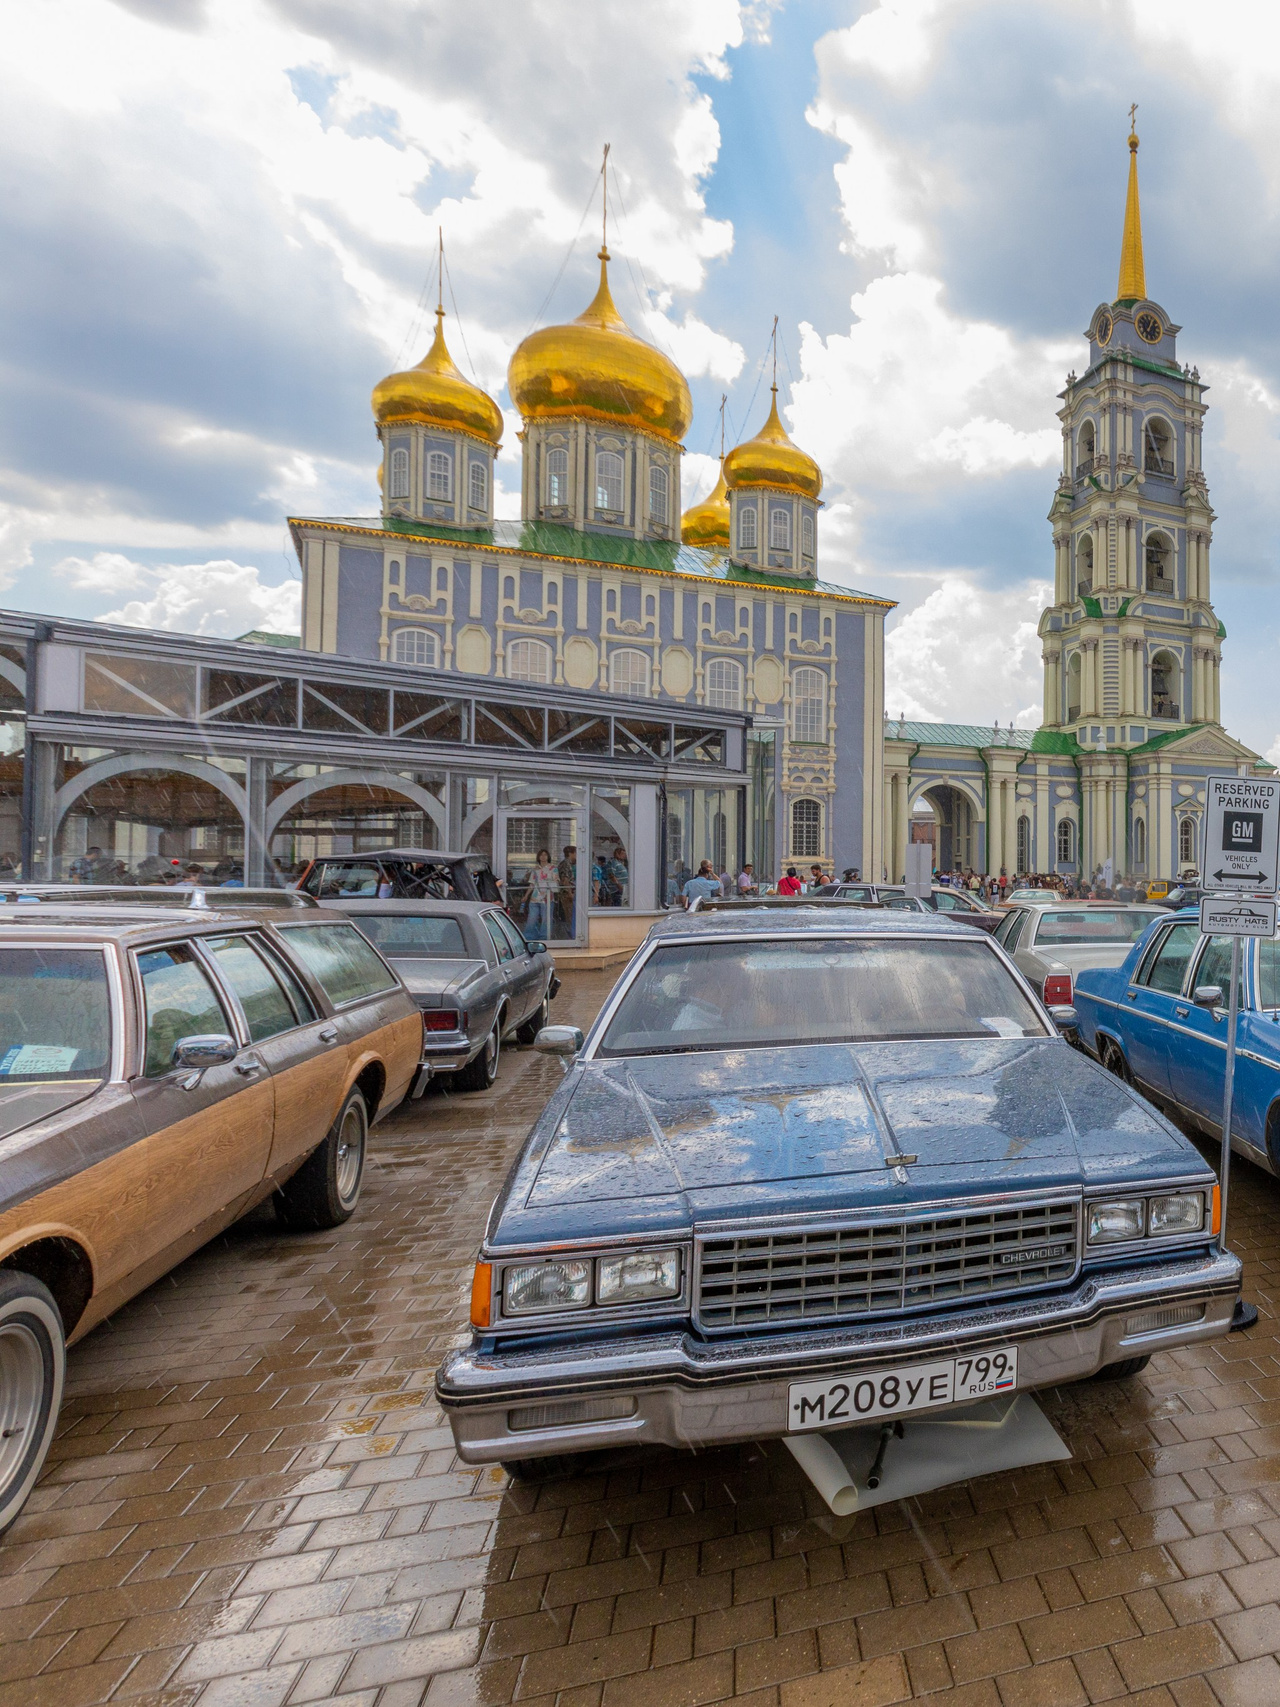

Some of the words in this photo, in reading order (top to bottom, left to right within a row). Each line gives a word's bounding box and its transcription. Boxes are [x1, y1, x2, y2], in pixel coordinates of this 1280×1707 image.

[1214, 783, 1275, 797] RESERVED
[1218, 796, 1270, 810] PARKING
[1232, 820, 1254, 838] GM
[1224, 854, 1258, 863] VEHICLES
[1231, 862, 1251, 870] ONLY
[1208, 915, 1240, 923] RUSTY
[1002, 1245, 1067, 1264] CHEVROLET
[957, 1352, 1008, 1386] 799
[969, 1381, 995, 1395] RUS
